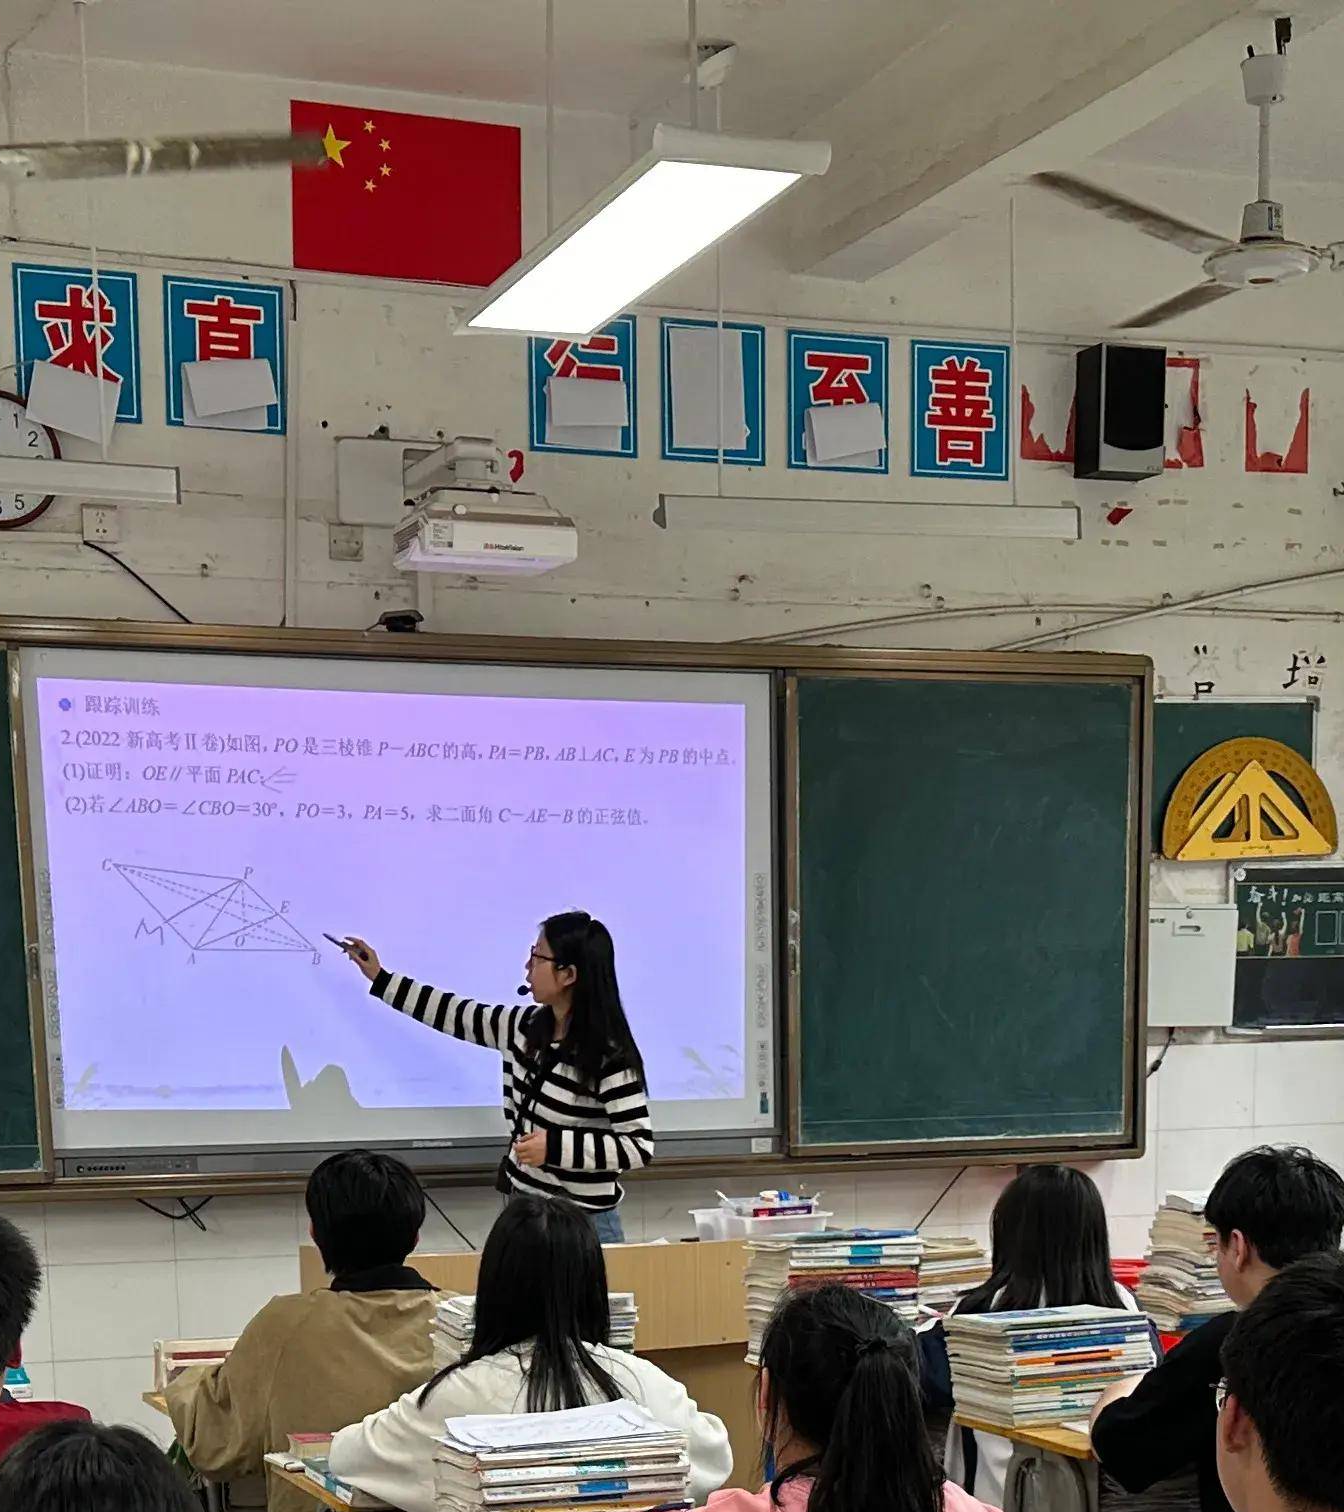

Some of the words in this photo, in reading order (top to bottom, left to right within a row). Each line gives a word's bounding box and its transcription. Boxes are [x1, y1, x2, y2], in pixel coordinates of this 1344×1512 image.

[925, 355, 997, 468] 善
[11, 413, 20, 429] 1
[27, 431, 39, 448] 2
[14, 493, 25, 511] 5
[84, 695, 161, 716] 跟踪训练
